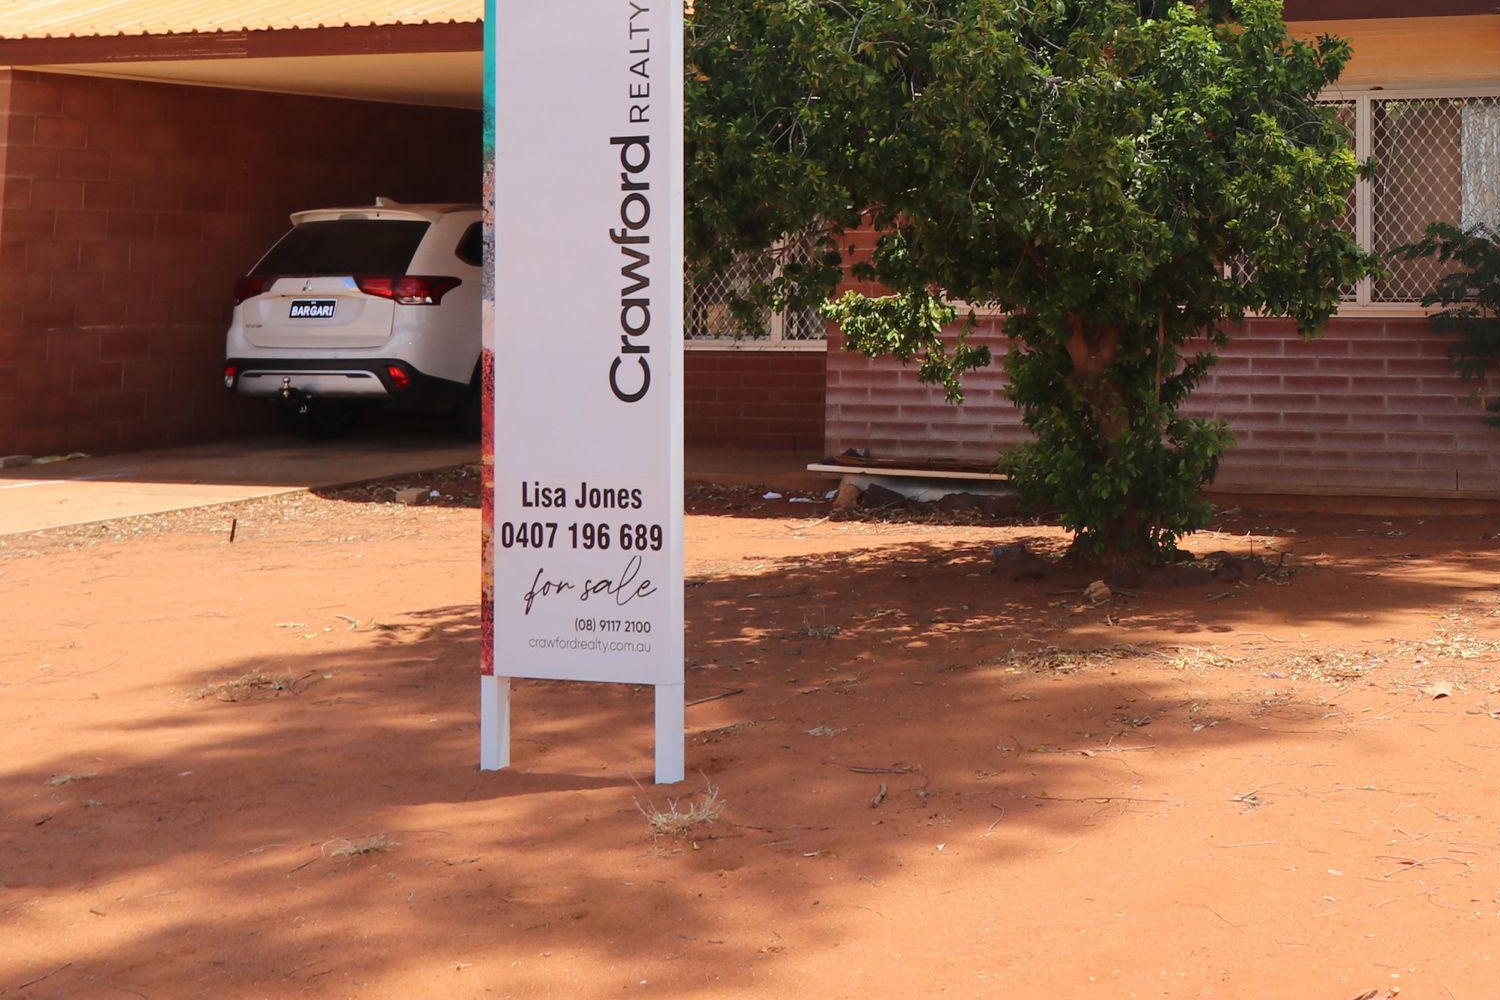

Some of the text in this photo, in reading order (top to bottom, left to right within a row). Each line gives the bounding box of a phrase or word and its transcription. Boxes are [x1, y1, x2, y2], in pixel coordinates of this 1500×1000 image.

[609, 1, 651, 403] Crawford REALTY
[521, 481, 643, 509] Lisa Jones
[501, 521, 663, 551] 0407 196 689
[524, 555, 658, 615] for sale
[574, 617, 651, 633] (08) 9117 2100
[528, 636, 651, 653] crawfordrealty.com.au
